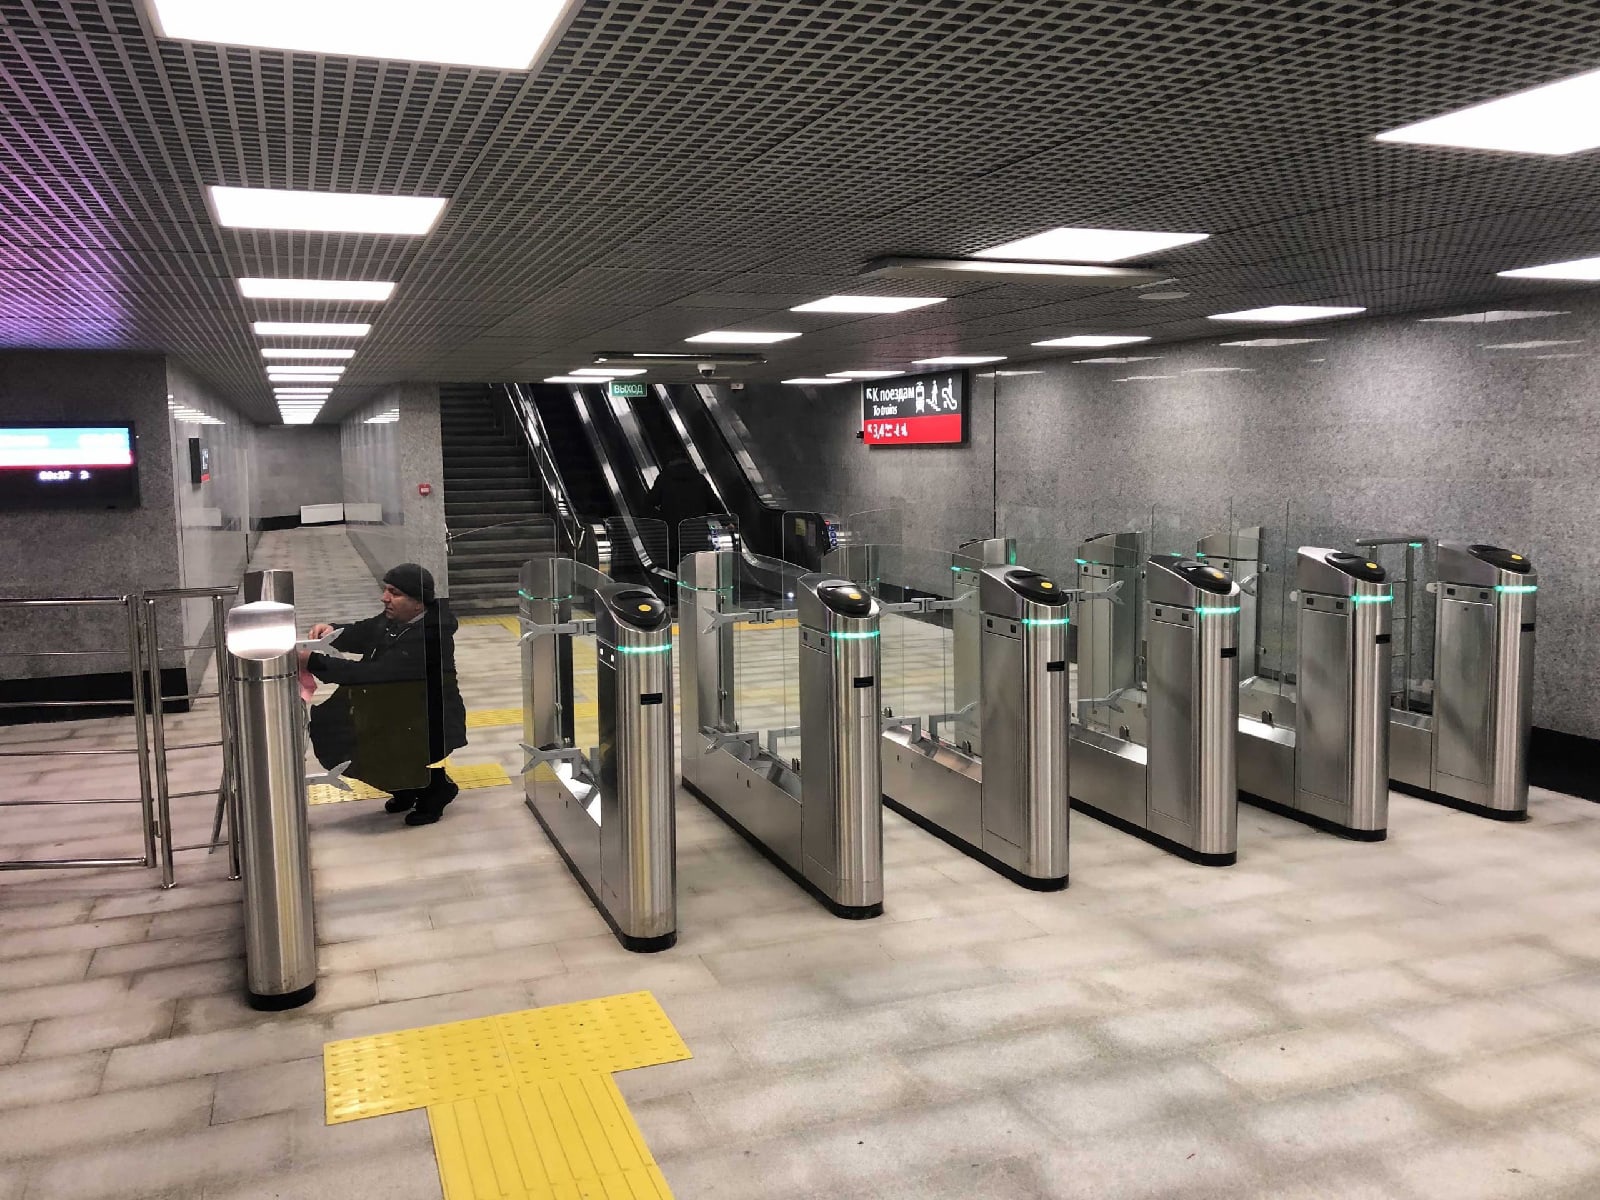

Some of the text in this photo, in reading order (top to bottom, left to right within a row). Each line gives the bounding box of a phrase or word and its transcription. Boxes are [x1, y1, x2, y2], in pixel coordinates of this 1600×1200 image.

[614, 384, 644, 395] ВЫХОД
[873, 386, 915, 402] К поездам
[873, 403, 897, 417] To trains
